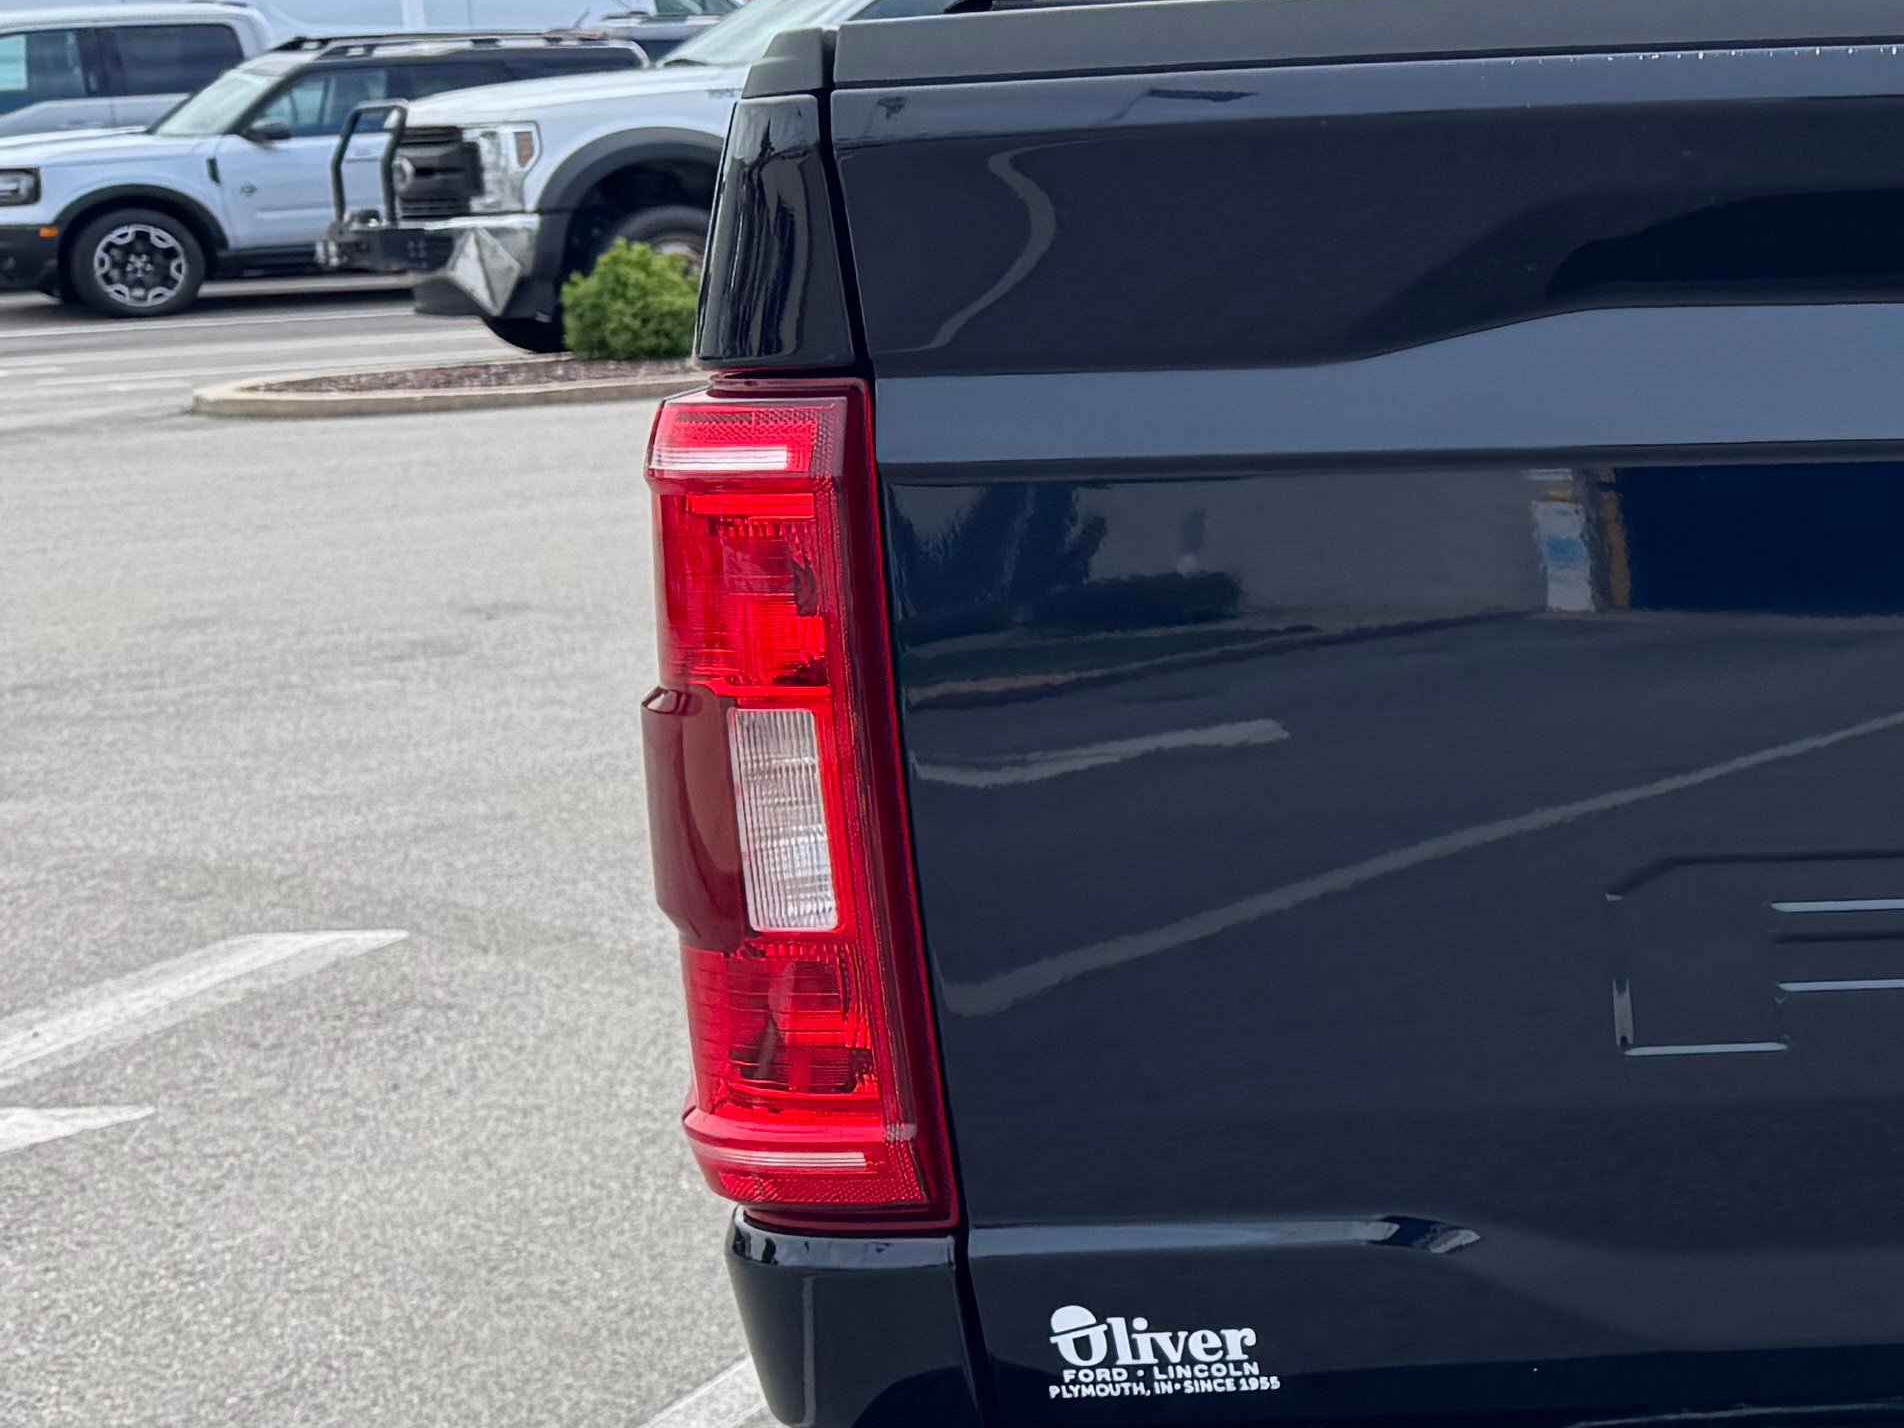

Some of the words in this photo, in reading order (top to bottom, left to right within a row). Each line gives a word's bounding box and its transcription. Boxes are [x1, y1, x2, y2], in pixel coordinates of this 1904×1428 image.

[1050, 1304, 1257, 1366] Oliver
[1063, 1368, 1128, 1383] FORD
[1153, 1361, 1260, 1380] LINCOLN
[1049, 1382, 1151, 1399] PLYMOUTH,
[1239, 1375, 1281, 1391] 1955
